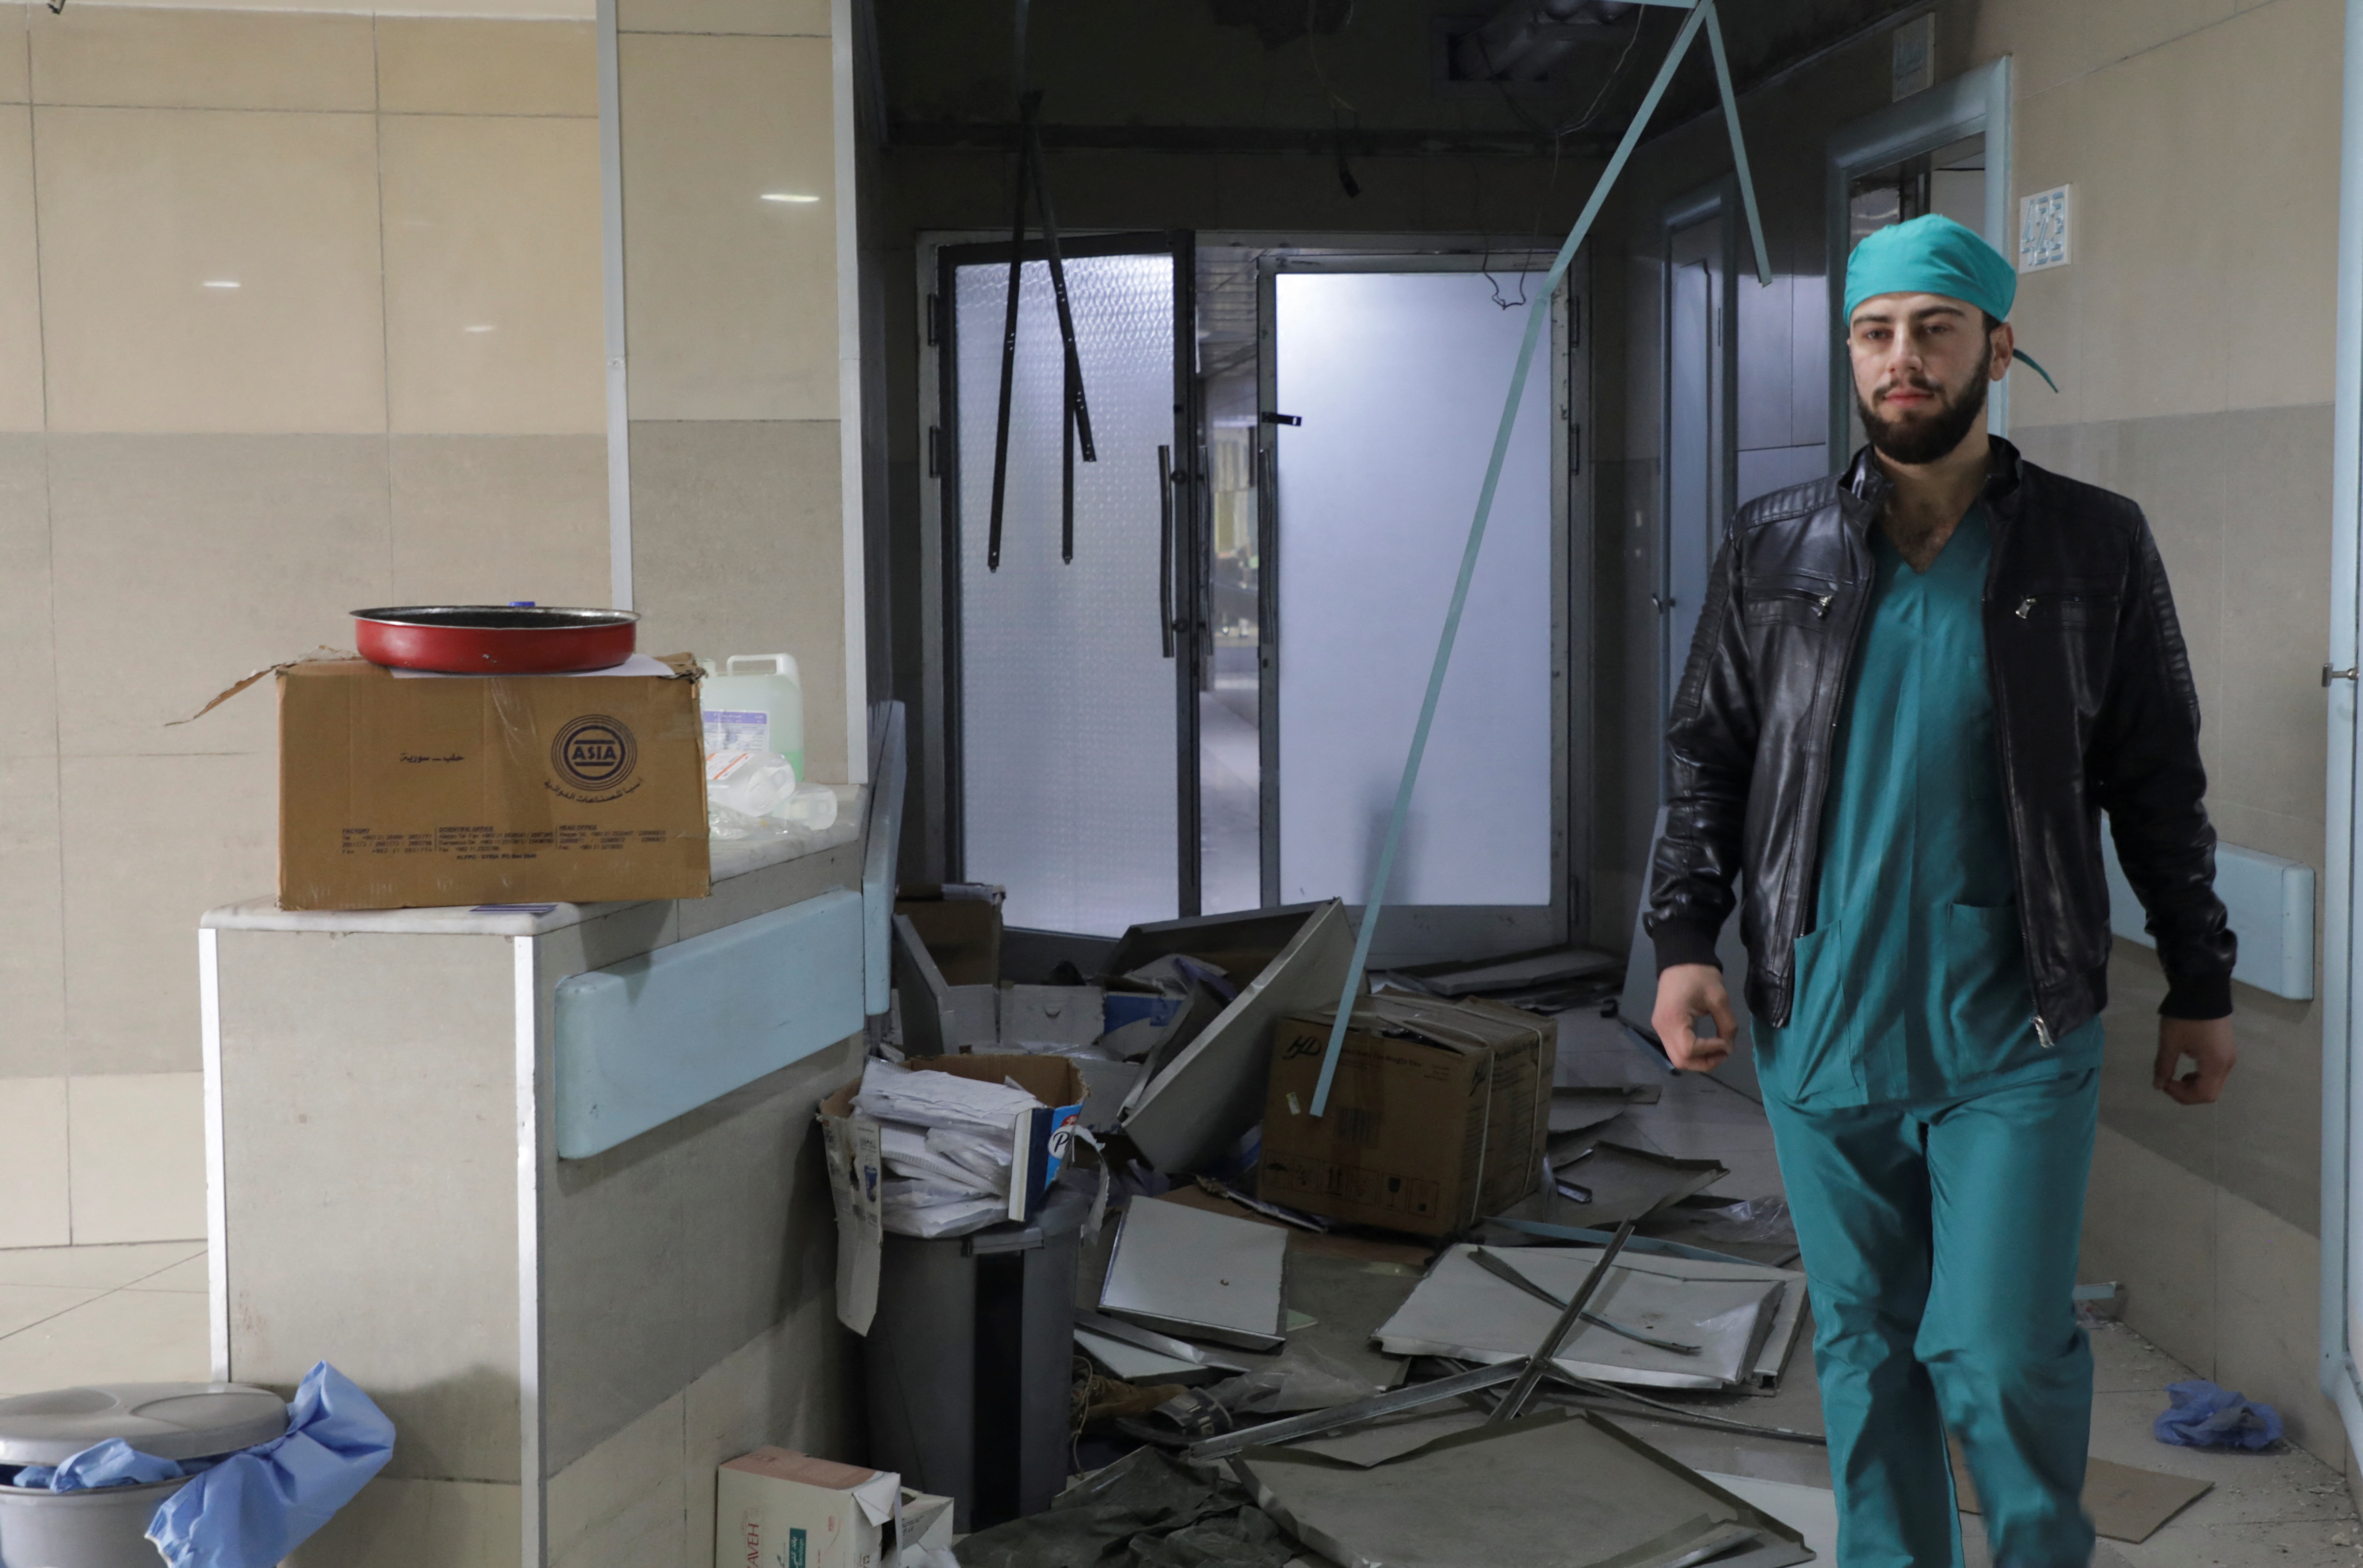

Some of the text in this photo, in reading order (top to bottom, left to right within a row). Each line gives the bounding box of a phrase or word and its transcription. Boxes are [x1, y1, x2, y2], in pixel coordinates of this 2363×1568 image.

[2020, 192, 2064, 266] 423
[400, 752, 430, 763] سورية
[443, 753, 464, 763] حلب
[572, 746, 617, 760] ASIA
[747, 1523, 760, 1568] AVEH
